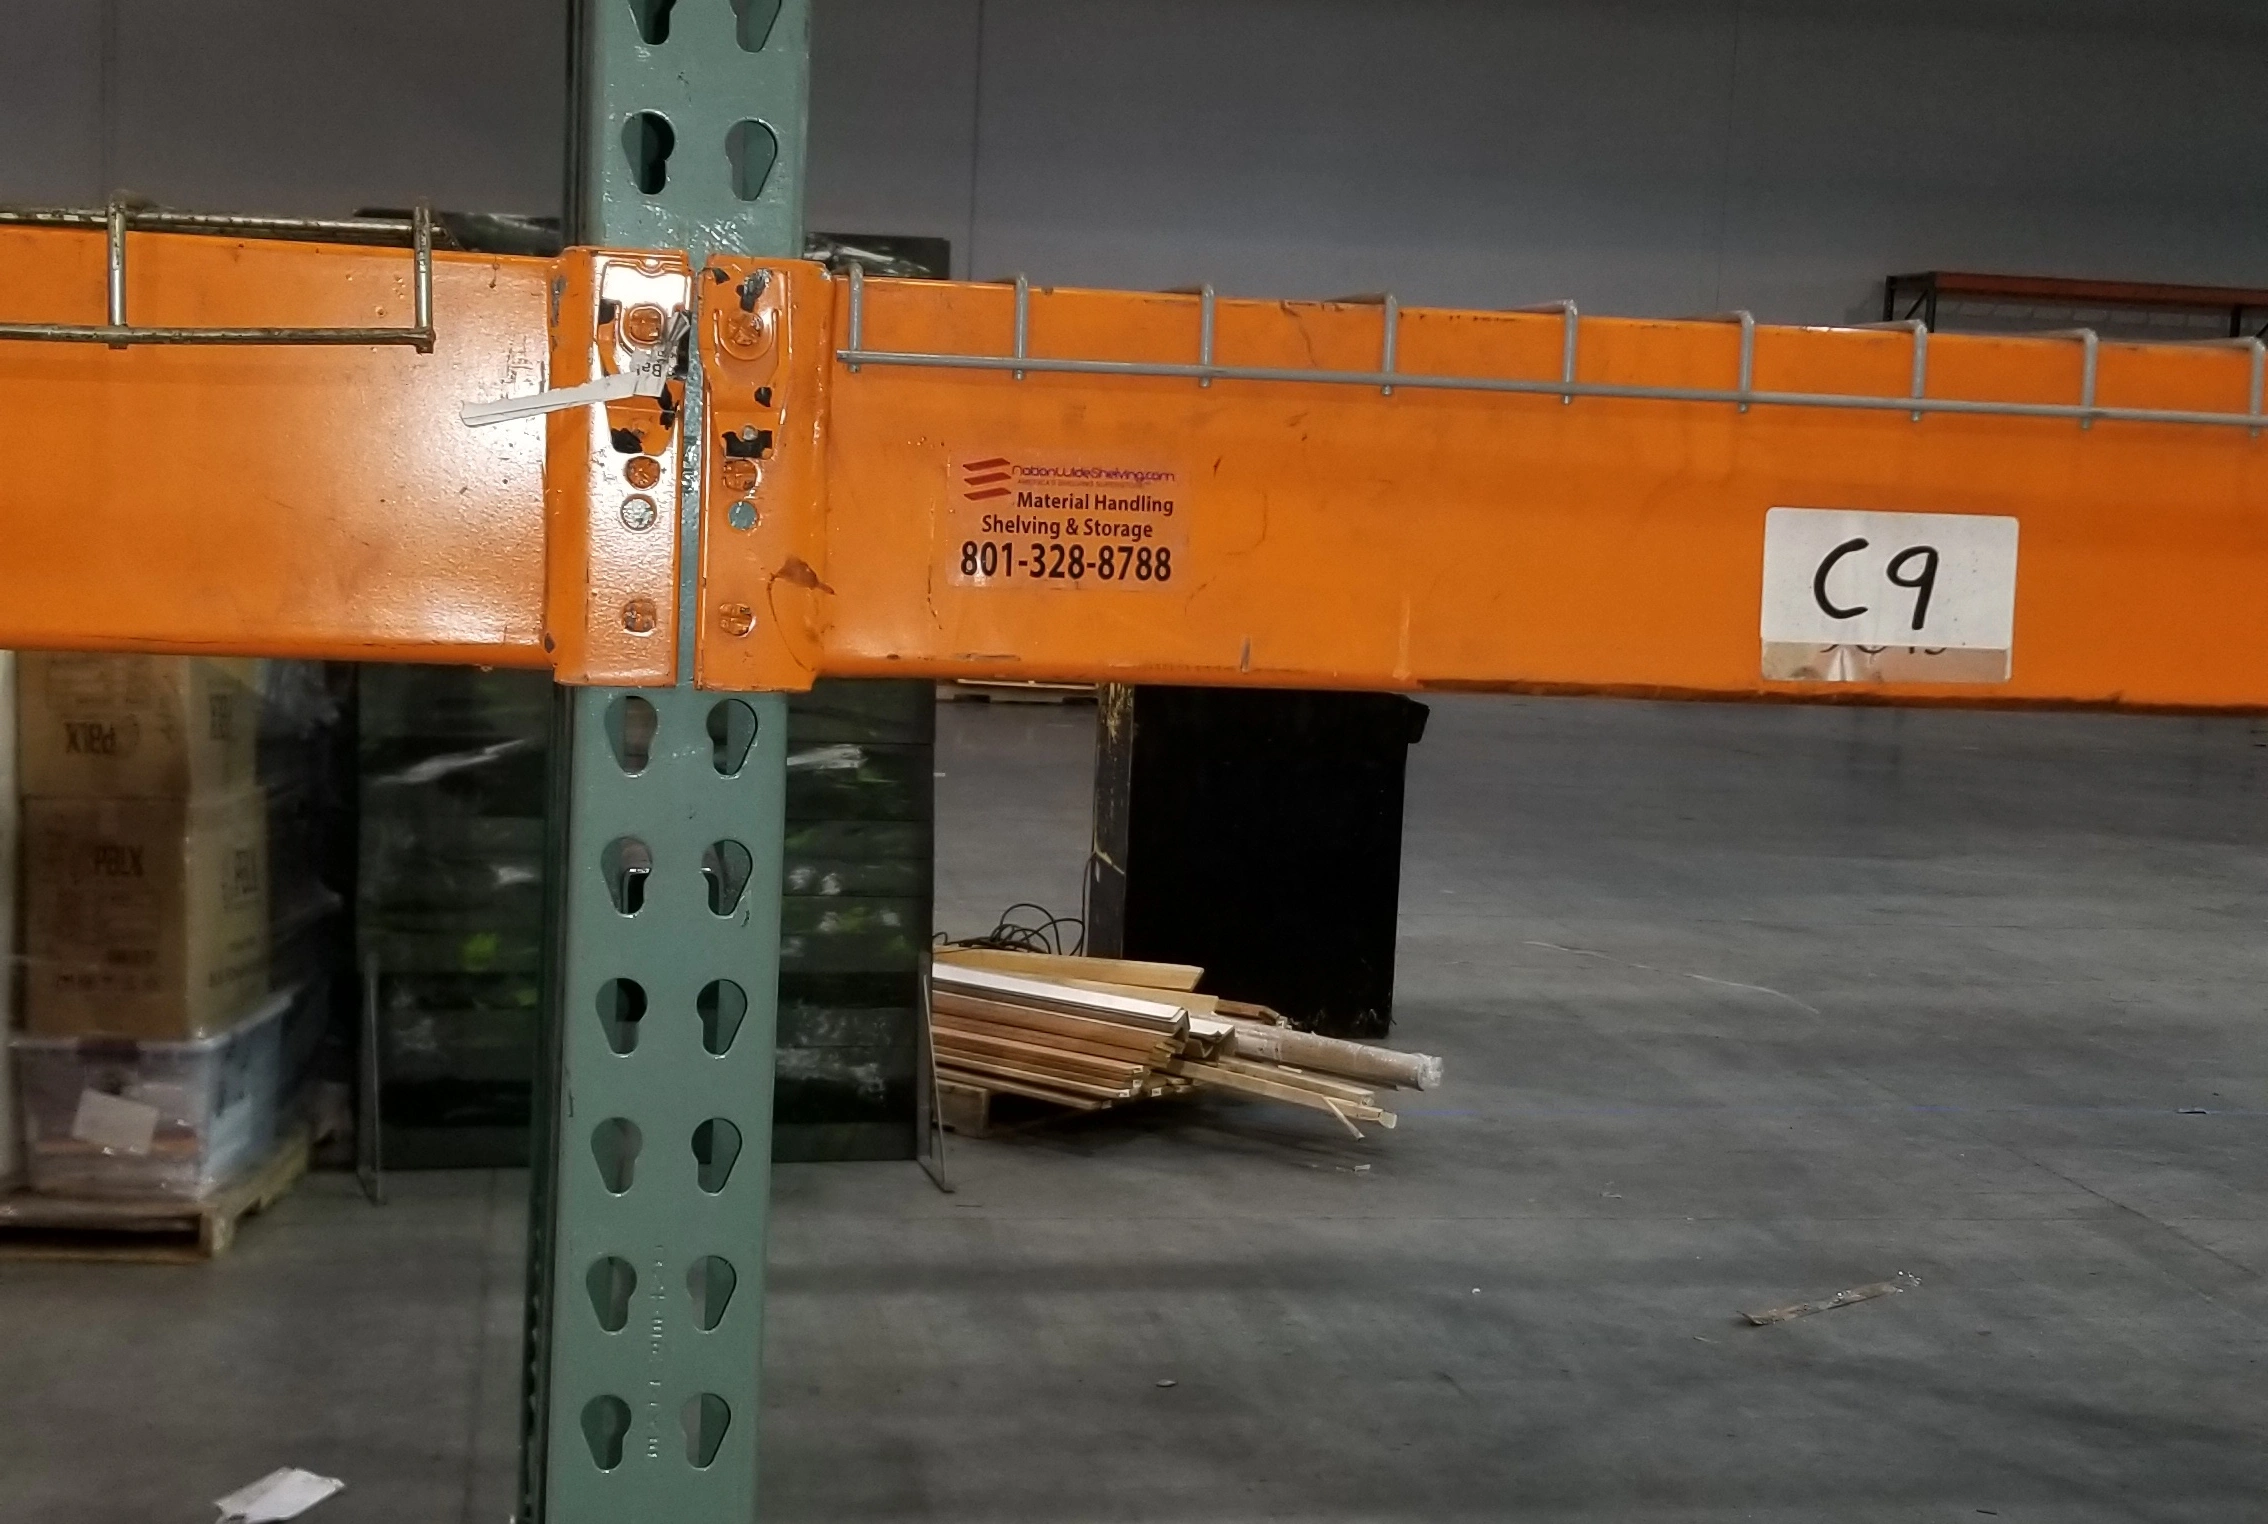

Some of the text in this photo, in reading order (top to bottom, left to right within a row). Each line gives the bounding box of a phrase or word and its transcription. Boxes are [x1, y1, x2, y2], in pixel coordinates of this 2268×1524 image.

[1017, 491, 1174, 516] Material Handling
[982, 514, 1153, 541] Shelving & Storage
[960, 540, 1172, 582] 801-328-8788
